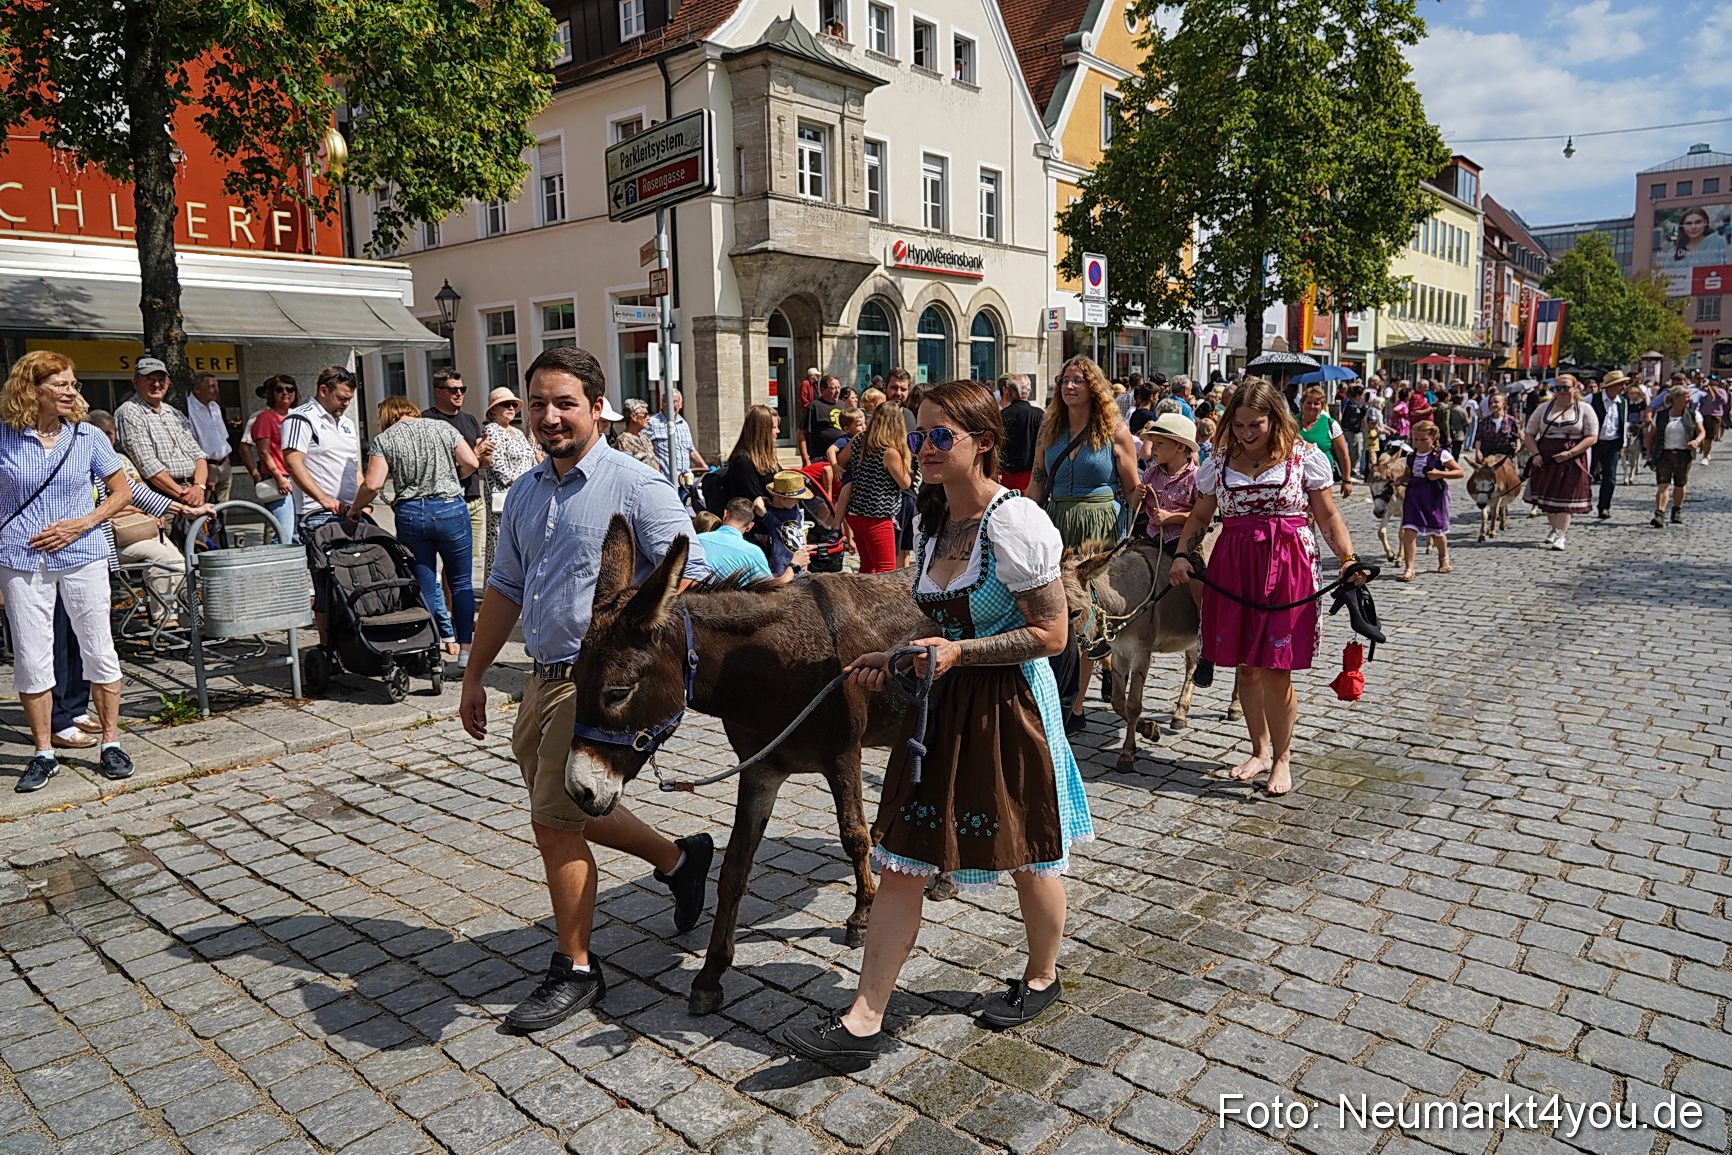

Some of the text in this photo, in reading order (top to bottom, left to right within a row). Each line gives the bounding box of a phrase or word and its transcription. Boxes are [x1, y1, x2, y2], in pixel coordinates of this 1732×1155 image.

[620, 132, 684, 170] Parkleitsystem
[642, 168, 685, 193] Rosengasse
[0, 181, 293, 246] CHLERF
[907, 243, 984, 269] HypoVereinsbank
[1090, 287, 1101, 296] ZONE
